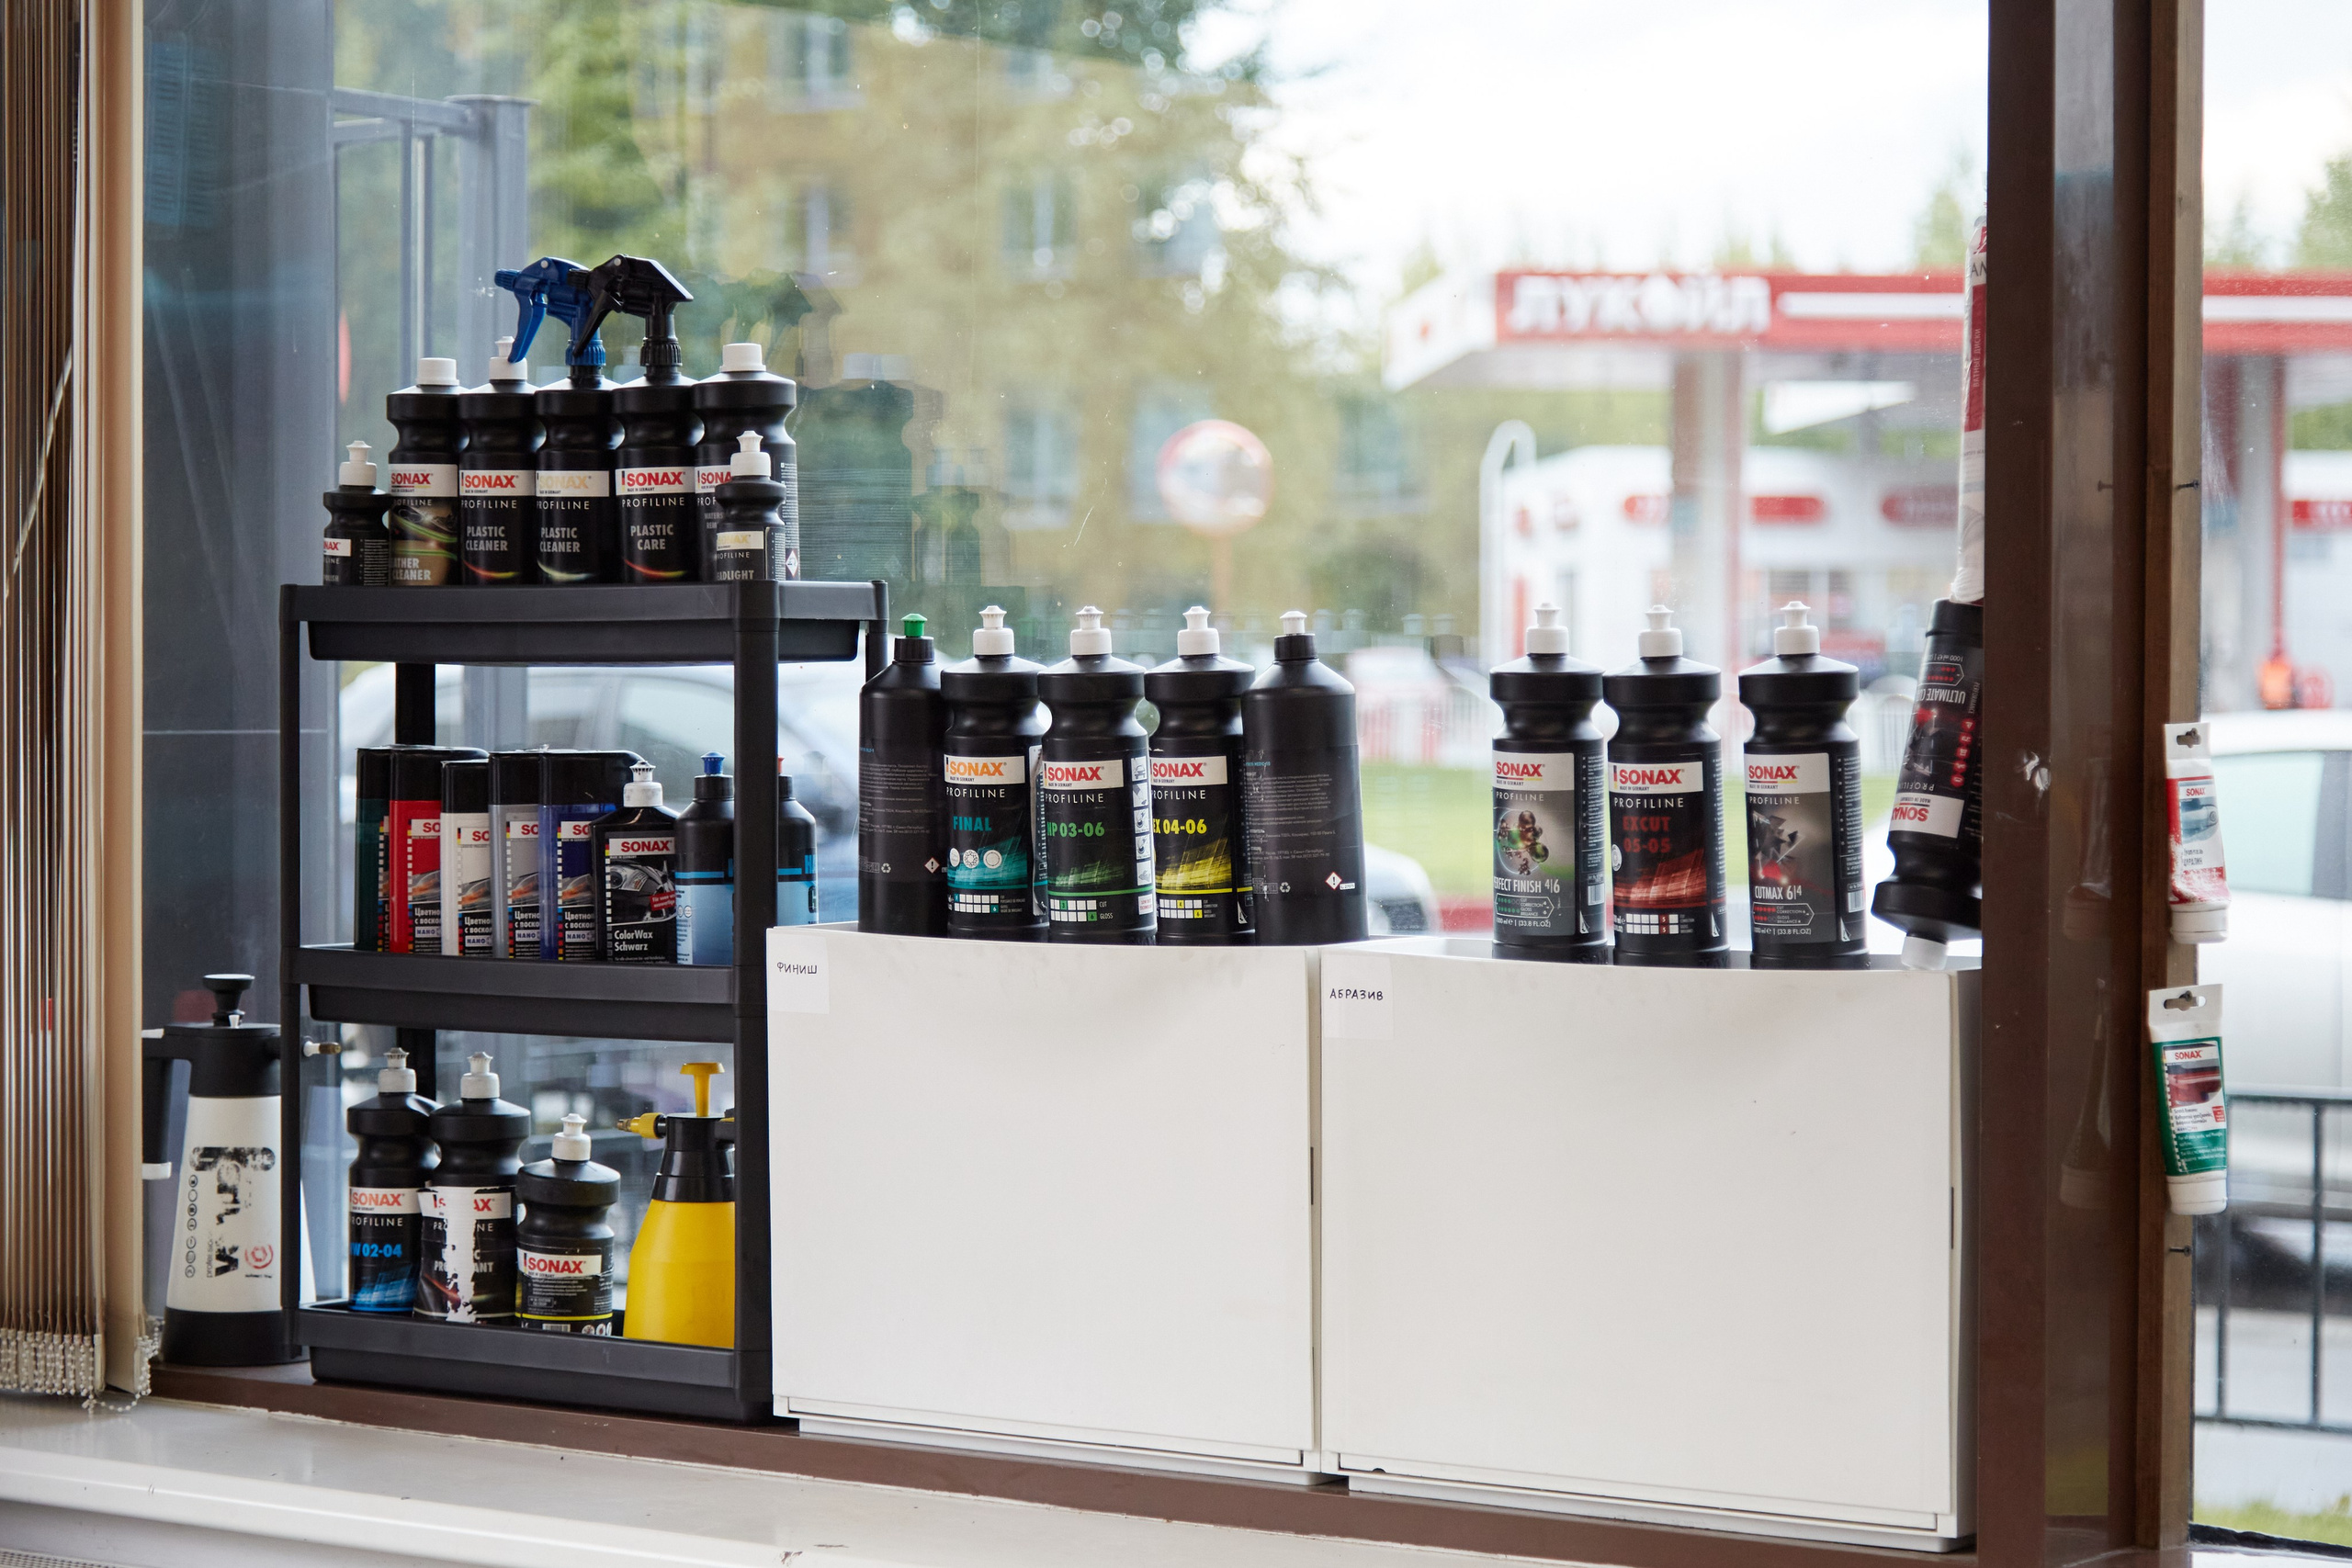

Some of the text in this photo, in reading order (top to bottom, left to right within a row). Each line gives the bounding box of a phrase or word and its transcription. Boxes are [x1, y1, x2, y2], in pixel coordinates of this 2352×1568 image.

[391, 473, 431, 485] SONAX
[465, 474, 515, 489] SONAX
[539, 475, 588, 489] SONAX
[627, 472, 684, 486] SONAX
[701, 472, 732, 484] SONA
[461, 500, 517, 509] PROFILINE
[537, 501, 590, 510] PROFILINE
[622, 497, 684, 508] PROFILINE
[467, 526, 505, 537] PLASTIC
[541, 527, 577, 538] PLASTIC
[630, 525, 673, 536] PLASTIC
[323, 542, 339, 551] NAX
[466, 540, 508, 551] CLEANER
[539, 541, 581, 552] CLEANER
[638, 539, 666, 550] CARE
[394, 558, 419, 569] ATHER
[718, 570, 754, 581] EADLIGHT
[1927, 688, 1966, 705] ULTIMATE
[950, 761, 1004, 776] SONAX
[1048, 766, 1102, 782] SONAX
[1153, 762, 1204, 778] SONAX
[1497, 761, 1543, 777] SONAX
[1748, 765, 1797, 779] SONAX
[1620, 769, 1682, 784] SONAX
[946, 787, 1005, 798] PROFILINE
[1153, 790, 1206, 800] ROFILINE
[1496, 792, 1544, 801] PROFILINE
[2187, 788, 2205, 796] SONAX
[1046, 793, 1103, 804] PROFILINE
[1614, 797, 1684, 808] PROFILINE
[1749, 796, 1800, 805] PROFILINE
[953, 816, 992, 831] FINAL
[1163, 818, 1207, 835] 04-06
[1623, 816, 1671, 832] EXCUT
[1059, 822, 1105, 838] 03-06
[621, 840, 670, 852] SONAX
[1623, 837, 1671, 853] 05-05
[1494, 876, 1511, 891] ERFECT
[1513, 880, 1542, 893] FINISH
[1755, 886, 1783, 899] CUTMAX
[415, 908, 440, 917] Цветно
[514, 911, 540, 919] Цветно
[565, 912, 593, 920] Цветно
[465, 917, 491, 926] Цветно
[615, 930, 653, 939] ColorWax
[615, 942, 648, 952] Schwarz
[776, 962, 818, 975] ФИНИШ
[1329, 987, 1384, 1000] АБРАЗИВ
[2175, 1050, 2202, 1060] SONAX
[353, 1192, 401, 1206] SONAX
[438, 1198, 492, 1212] SAX
[352, 1217, 403, 1227] ROFILINE
[362, 1244, 402, 1258] 02-04
[435, 1260, 494, 1273] PROANT
[528, 1258, 582, 1274] SONAX
